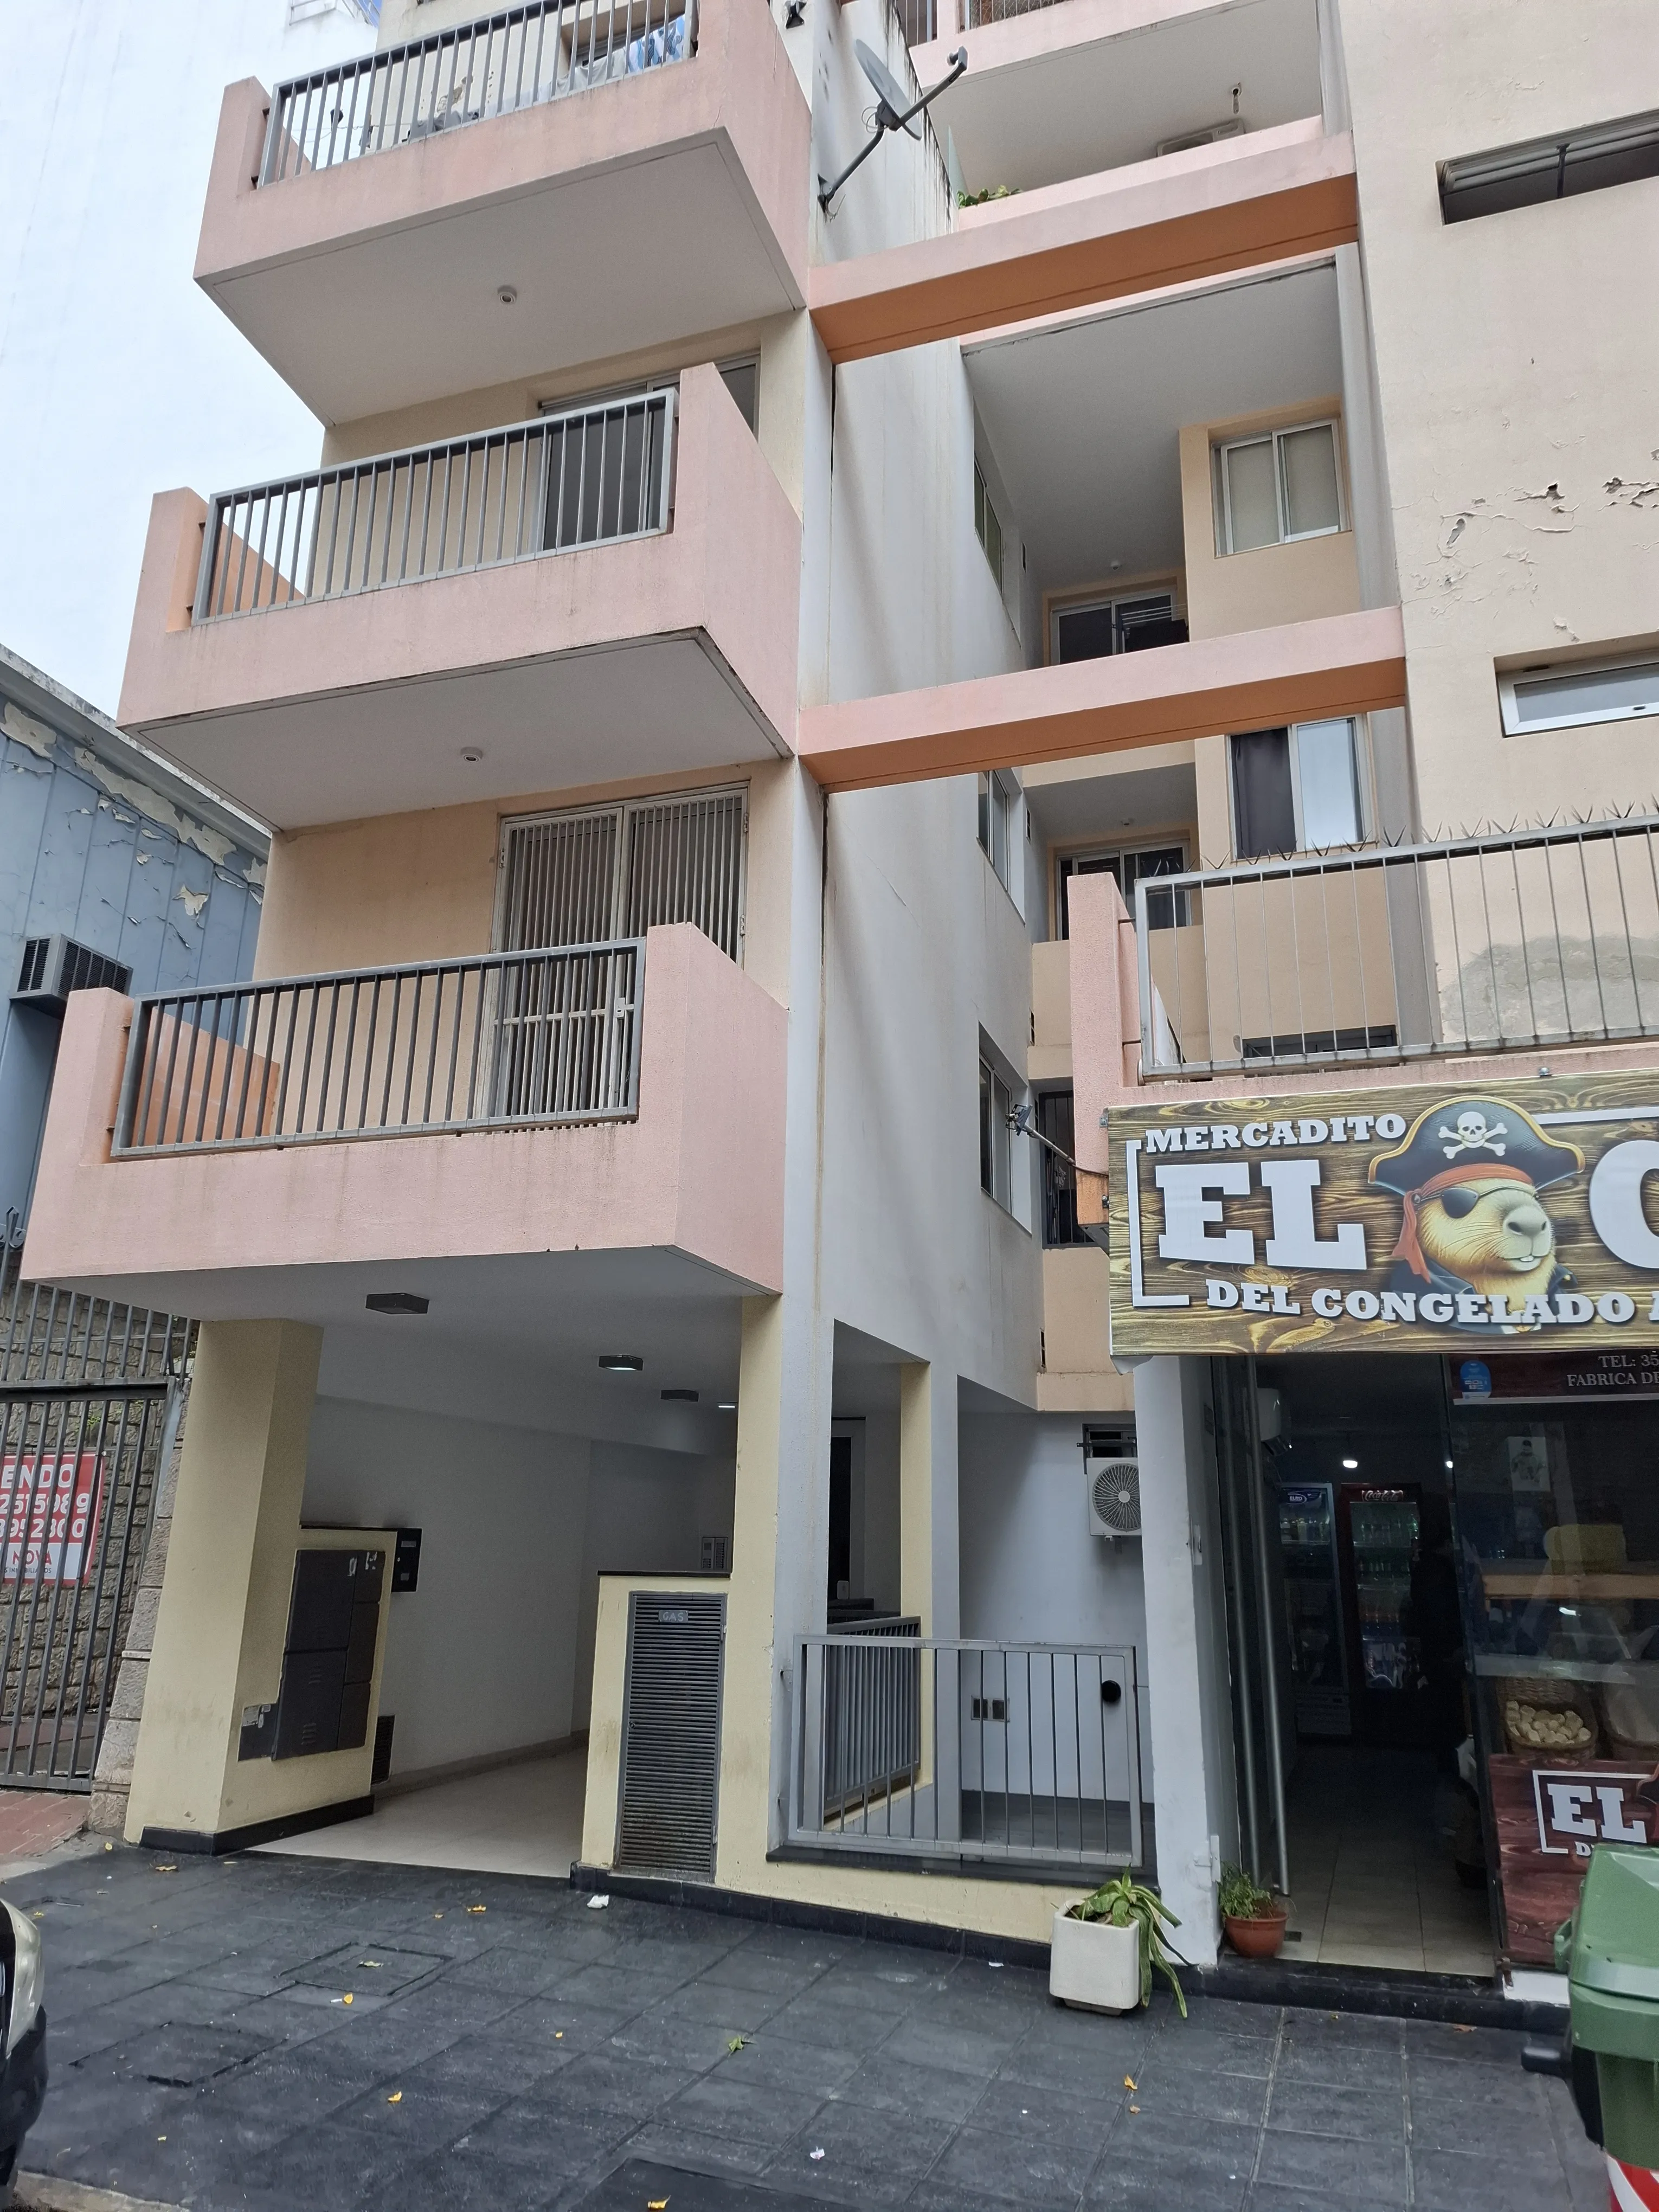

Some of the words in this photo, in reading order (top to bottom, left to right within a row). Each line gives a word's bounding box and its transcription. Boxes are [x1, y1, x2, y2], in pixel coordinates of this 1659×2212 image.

[1146, 1114, 1406, 1153] MERCADITO
[1155, 1159, 1368, 1270] EL
[1205, 1278, 1301, 1314] DEL
[1310, 1288, 1636, 1323] CONGELADO
[1566, 1372, 1638, 1386] FABRICA
[1598, 1355, 1636, 1368] TEL:
[663, 1611, 684, 1622] GAS
[1547, 1783, 1647, 1844] EL
